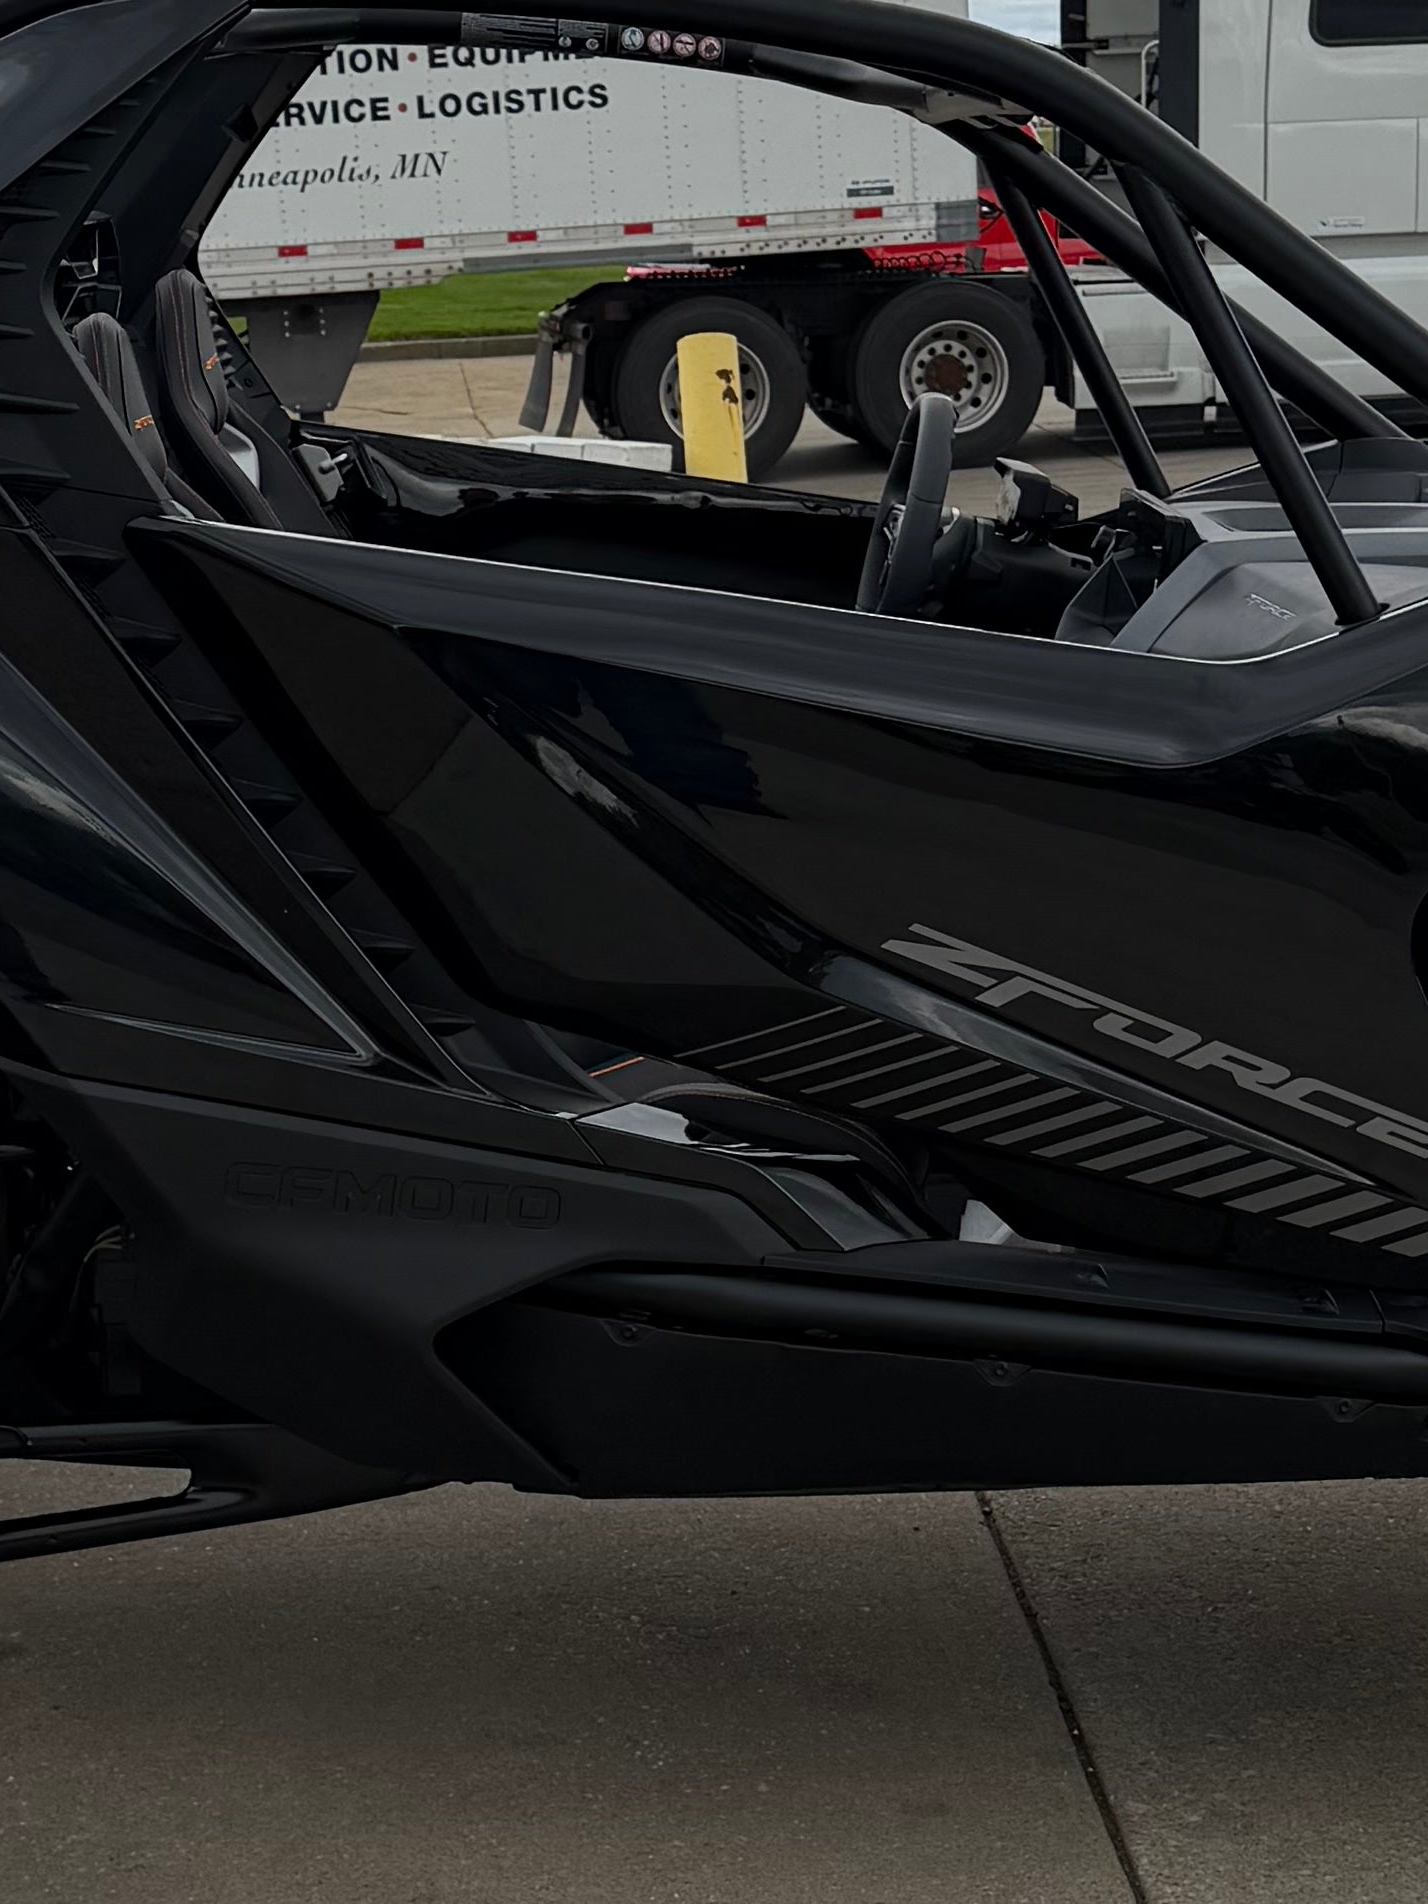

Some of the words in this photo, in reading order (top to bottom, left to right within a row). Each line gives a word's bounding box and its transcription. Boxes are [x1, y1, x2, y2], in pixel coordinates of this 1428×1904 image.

[271, 96, 392, 128] RVICE
[416, 83, 610, 120] LOGISTICS
[389, 149, 450, 181] MN
[224, 1161, 562, 1231] CFMOTO
